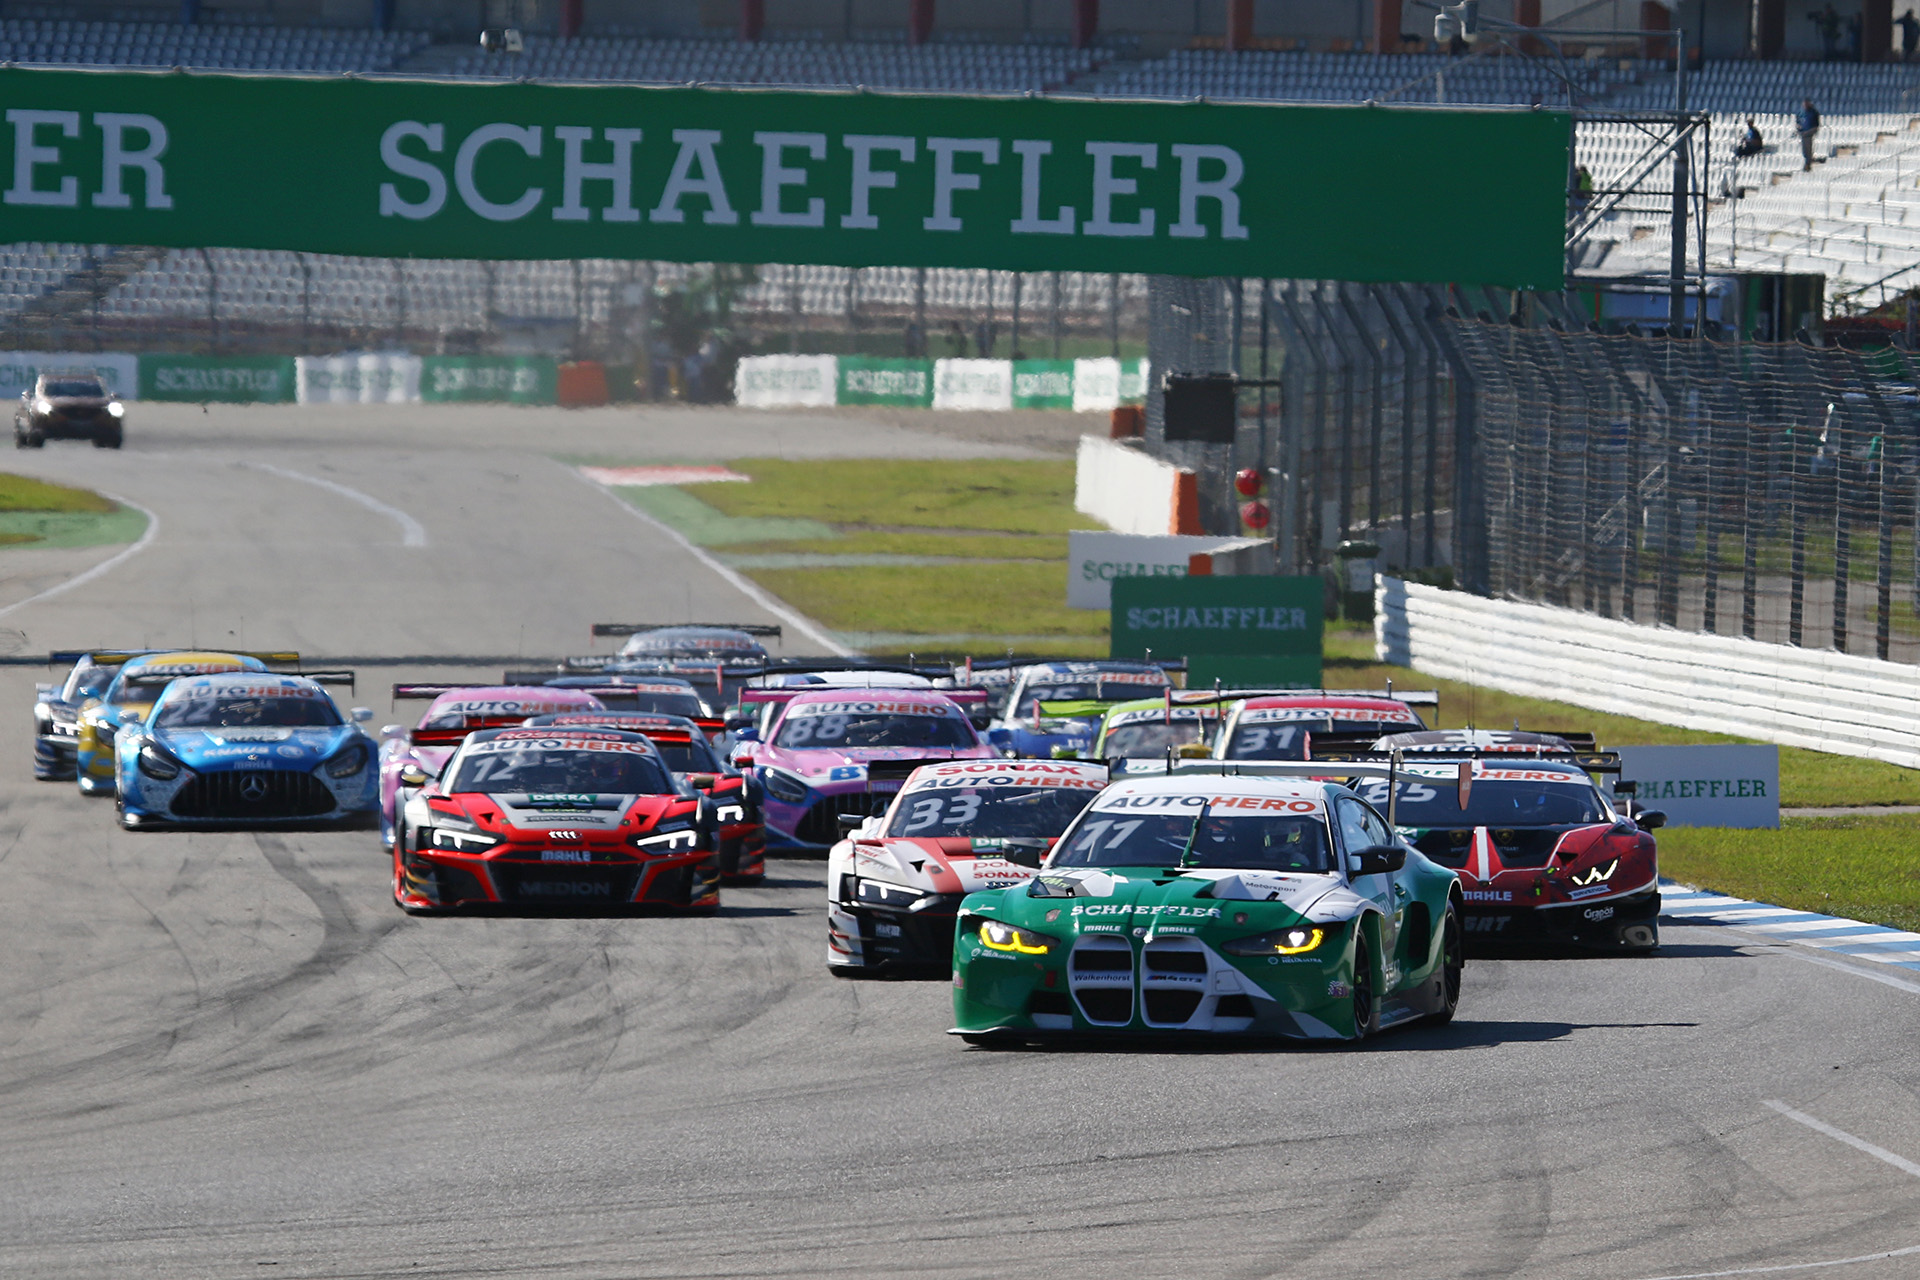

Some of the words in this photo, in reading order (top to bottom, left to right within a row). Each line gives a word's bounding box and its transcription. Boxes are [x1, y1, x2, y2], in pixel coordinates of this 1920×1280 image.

[379, 120, 1250, 240] SCHAEFFLER
[1083, 560, 1188, 580] SCHAEF
[1127, 606, 1306, 630] SCHAEFFLER
[185, 686, 314, 698] AUTOHERO
[803, 702, 948, 716] AUTOHERO
[1255, 709, 1410, 722] AUTOHERO
[782, 716, 850, 744] 88
[479, 740, 647, 754] AUTOHERO
[1237, 726, 1297, 754] 31
[472, 756, 522, 783] 12
[936, 764, 1083, 776] SONAX
[1474, 771, 1572, 782] HERO
[916, 776, 1108, 790] AUTOHERO
[1362, 780, 1438, 804] 85
[1103, 796, 1317, 813] AUTOHERO
[903, 795, 983, 832] 33
[1074, 819, 1145, 851] 11
[541, 850, 592, 862] MAHLE
[518, 881, 612, 896] MEDION
[1245, 881, 1297, 893] Motorsport
[1463, 890, 1513, 901] MAHLE
[1070, 904, 1224, 919] SCHAEFFLER
[1158, 926, 1195, 934] MAHLE
[1074, 974, 1131, 982] Walkenhorst
